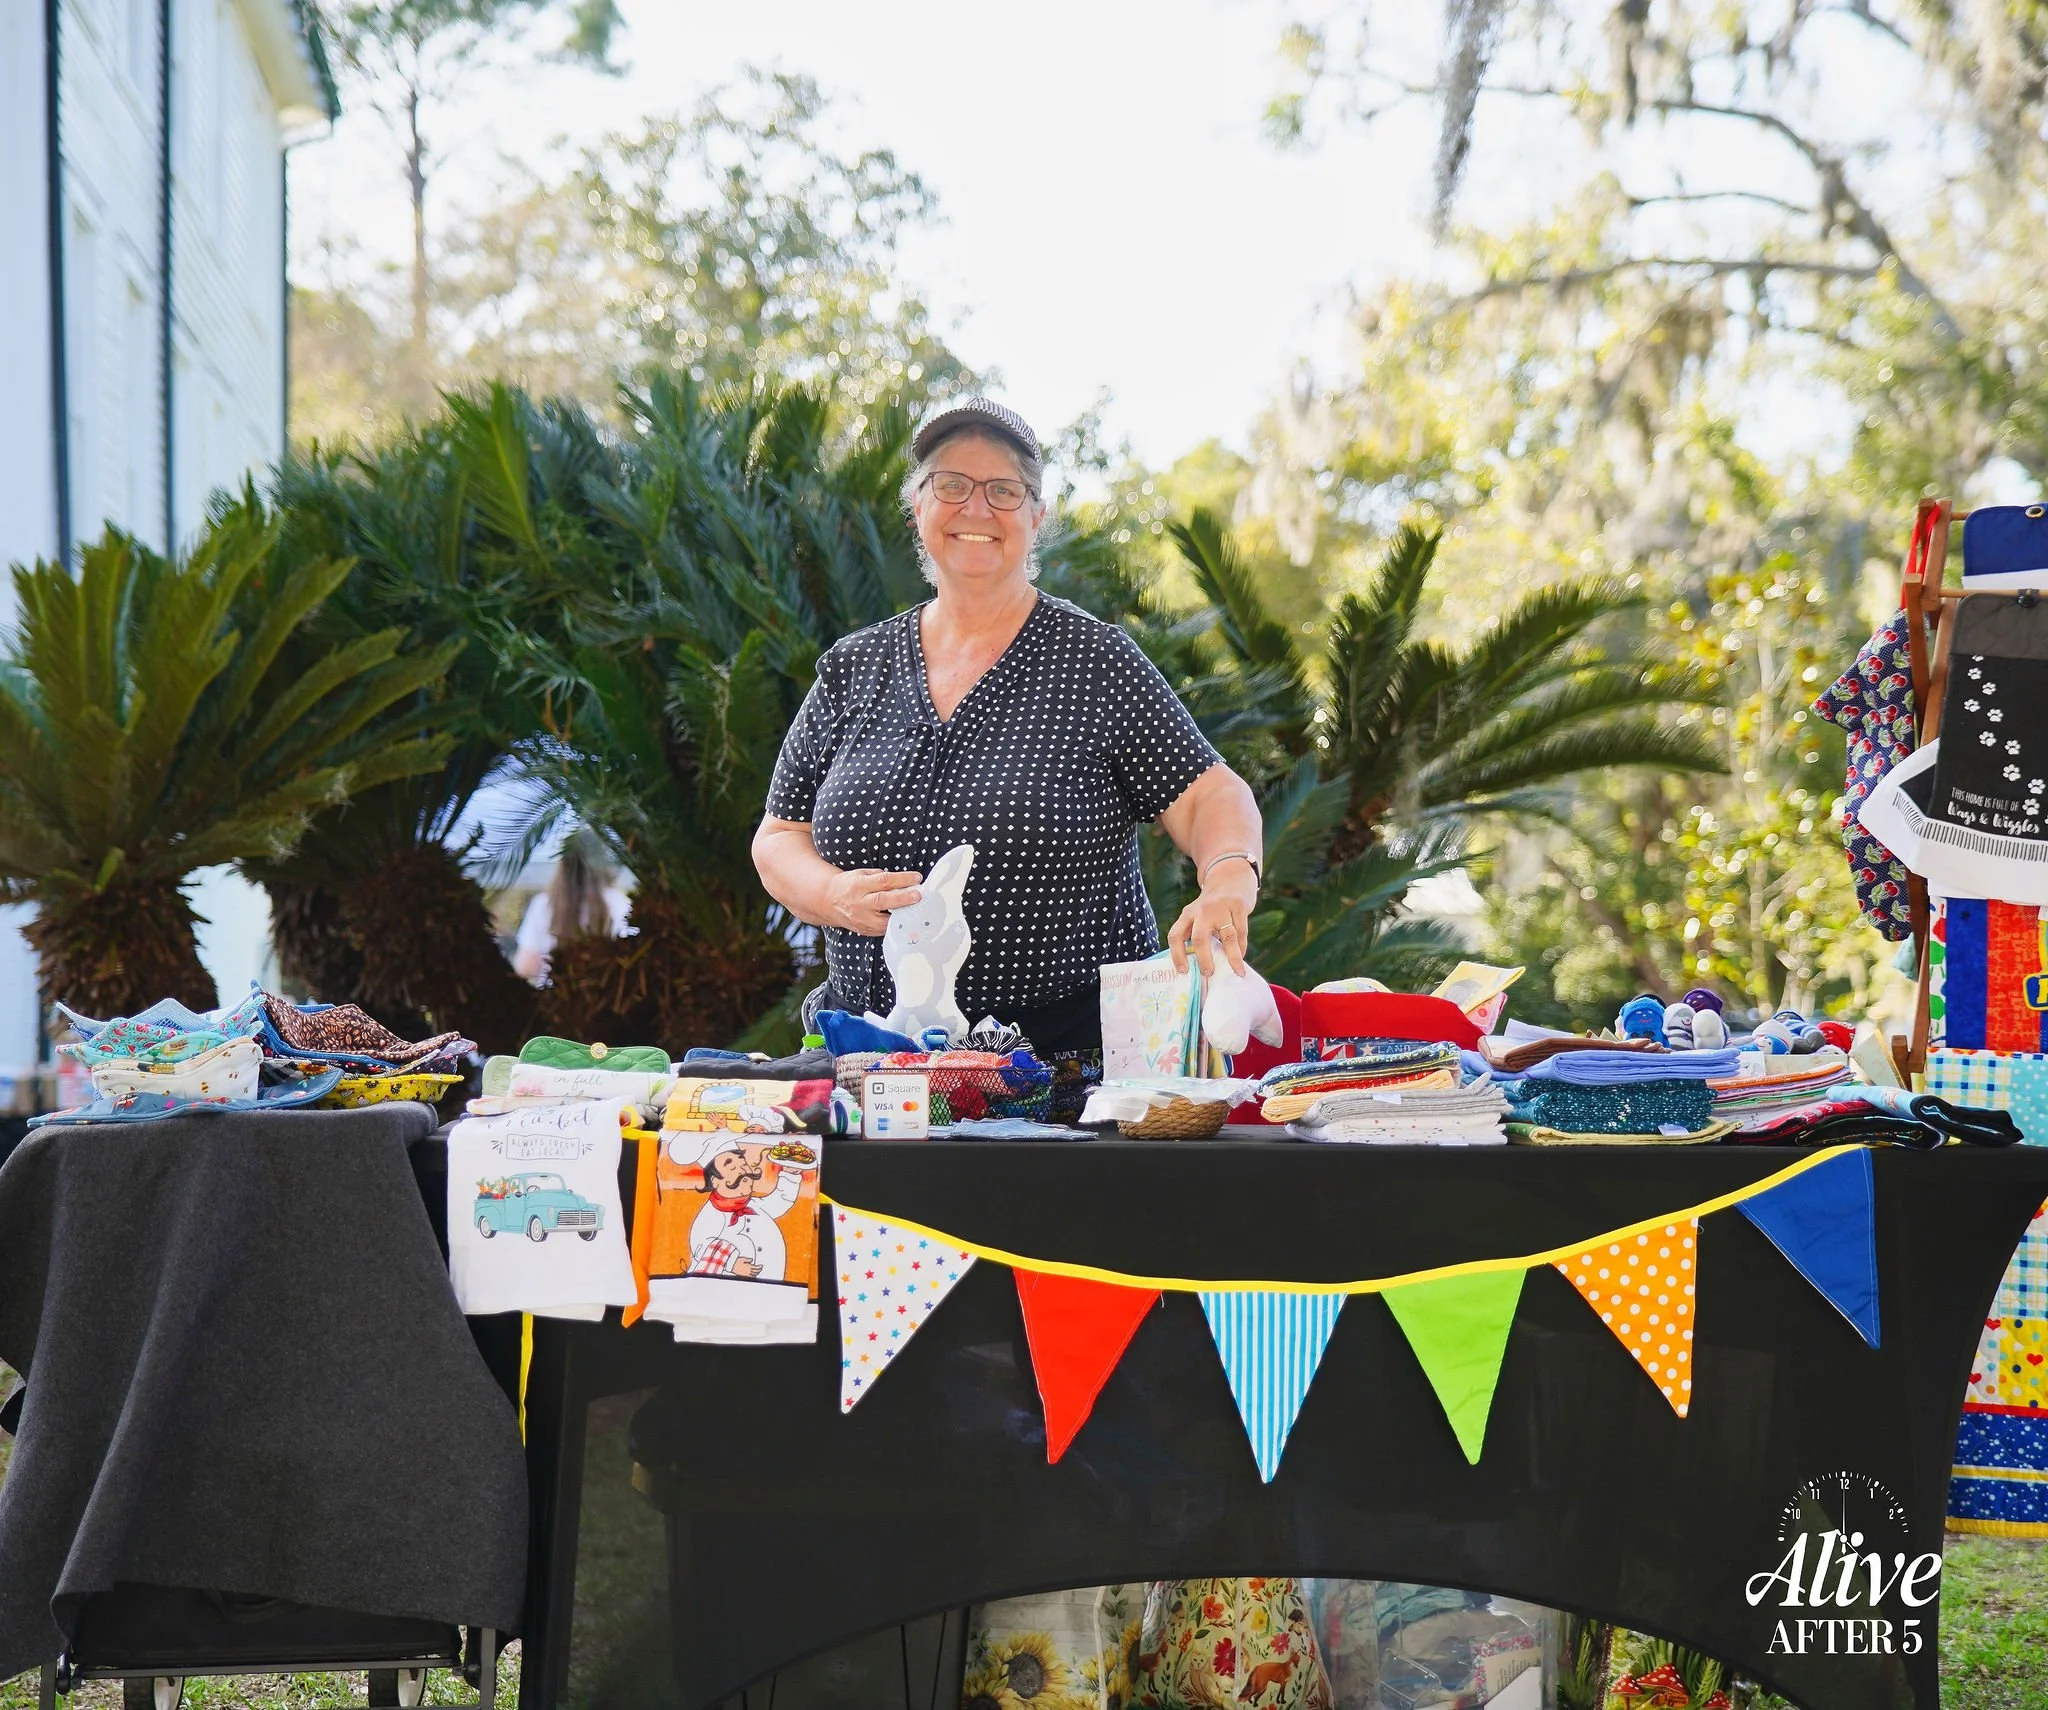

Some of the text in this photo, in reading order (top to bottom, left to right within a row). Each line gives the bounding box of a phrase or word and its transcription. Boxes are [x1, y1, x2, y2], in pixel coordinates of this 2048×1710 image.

[1951, 786, 2019, 811] THIS HOME IS FULL OF
[1947, 801, 2040, 835] Wags & Wiggles
[887, 1084, 921, 1095] Square
[512, 1137, 545, 1148] ALWAYS
